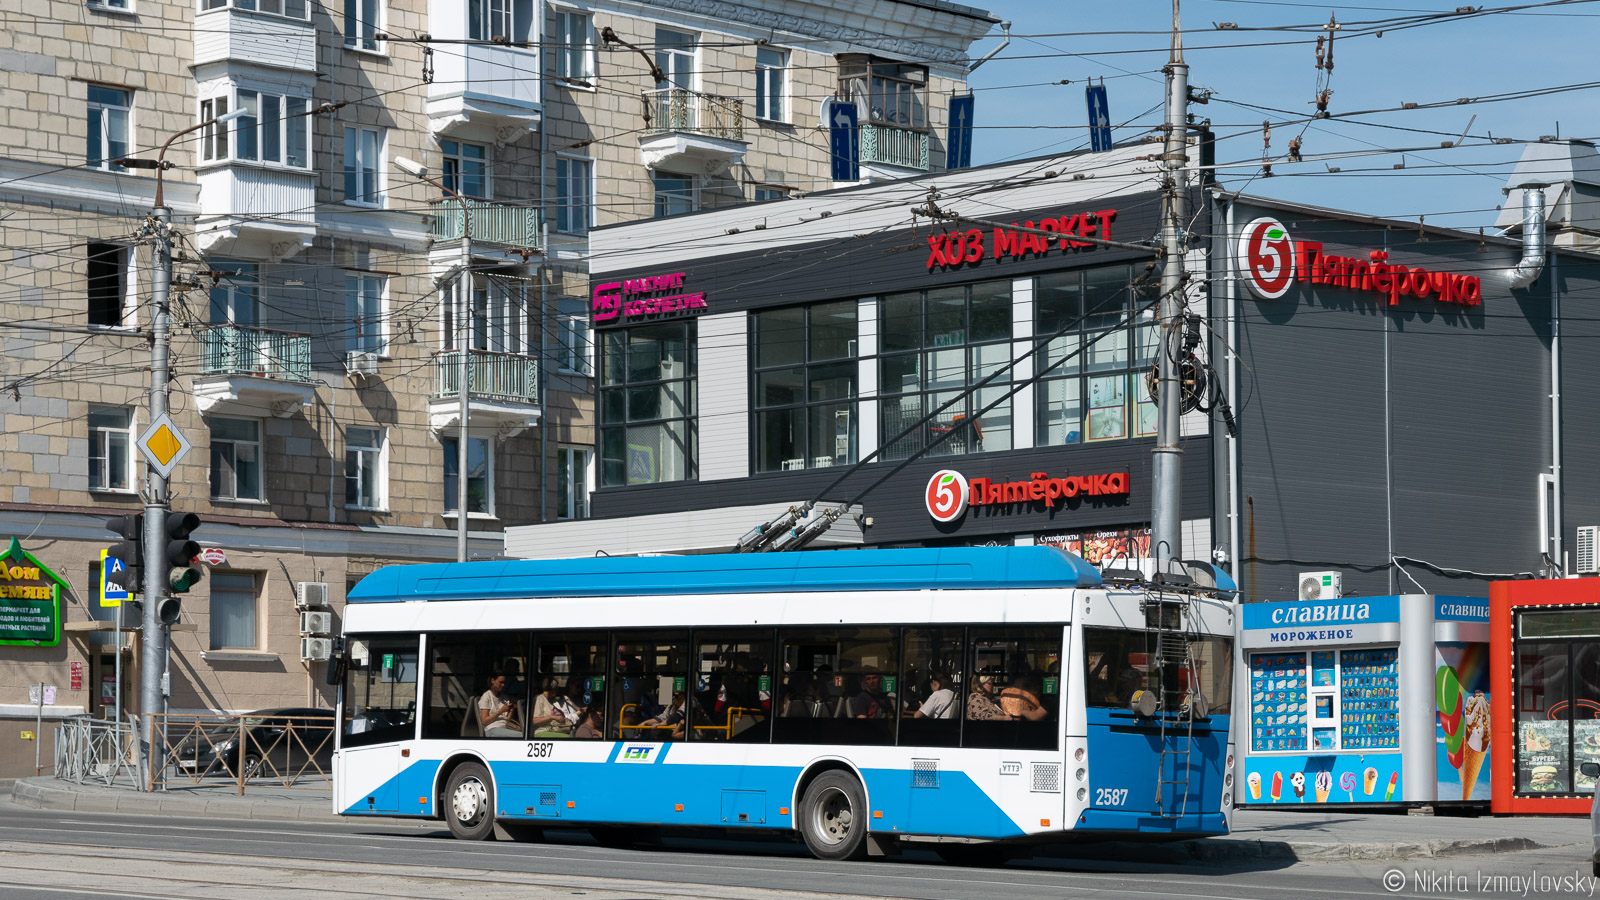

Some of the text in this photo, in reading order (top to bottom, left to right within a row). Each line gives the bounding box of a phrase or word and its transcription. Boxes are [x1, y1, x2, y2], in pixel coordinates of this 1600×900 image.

[926, 209, 1118, 269] ХОЗ МАРКЕТ
[623, 272, 686, 294] МАГНИТ
[1295, 240, 1482, 306] Пятёрочка
[623, 291, 708, 316] КОСМЕТИК
[969, 472, 1130, 507] Пятёрочка
[1040, 534, 1079, 544] Сухофрукты
[1096, 530, 1118, 539] Орехи
[0, 560, 40, 581] Дом
[1271, 603, 1370, 624] славица
[1270, 629, 1354, 642] МОРОЖЕНОЕ
[527, 742, 554, 758] 2587
[1095, 788, 1129, 806] 2587
